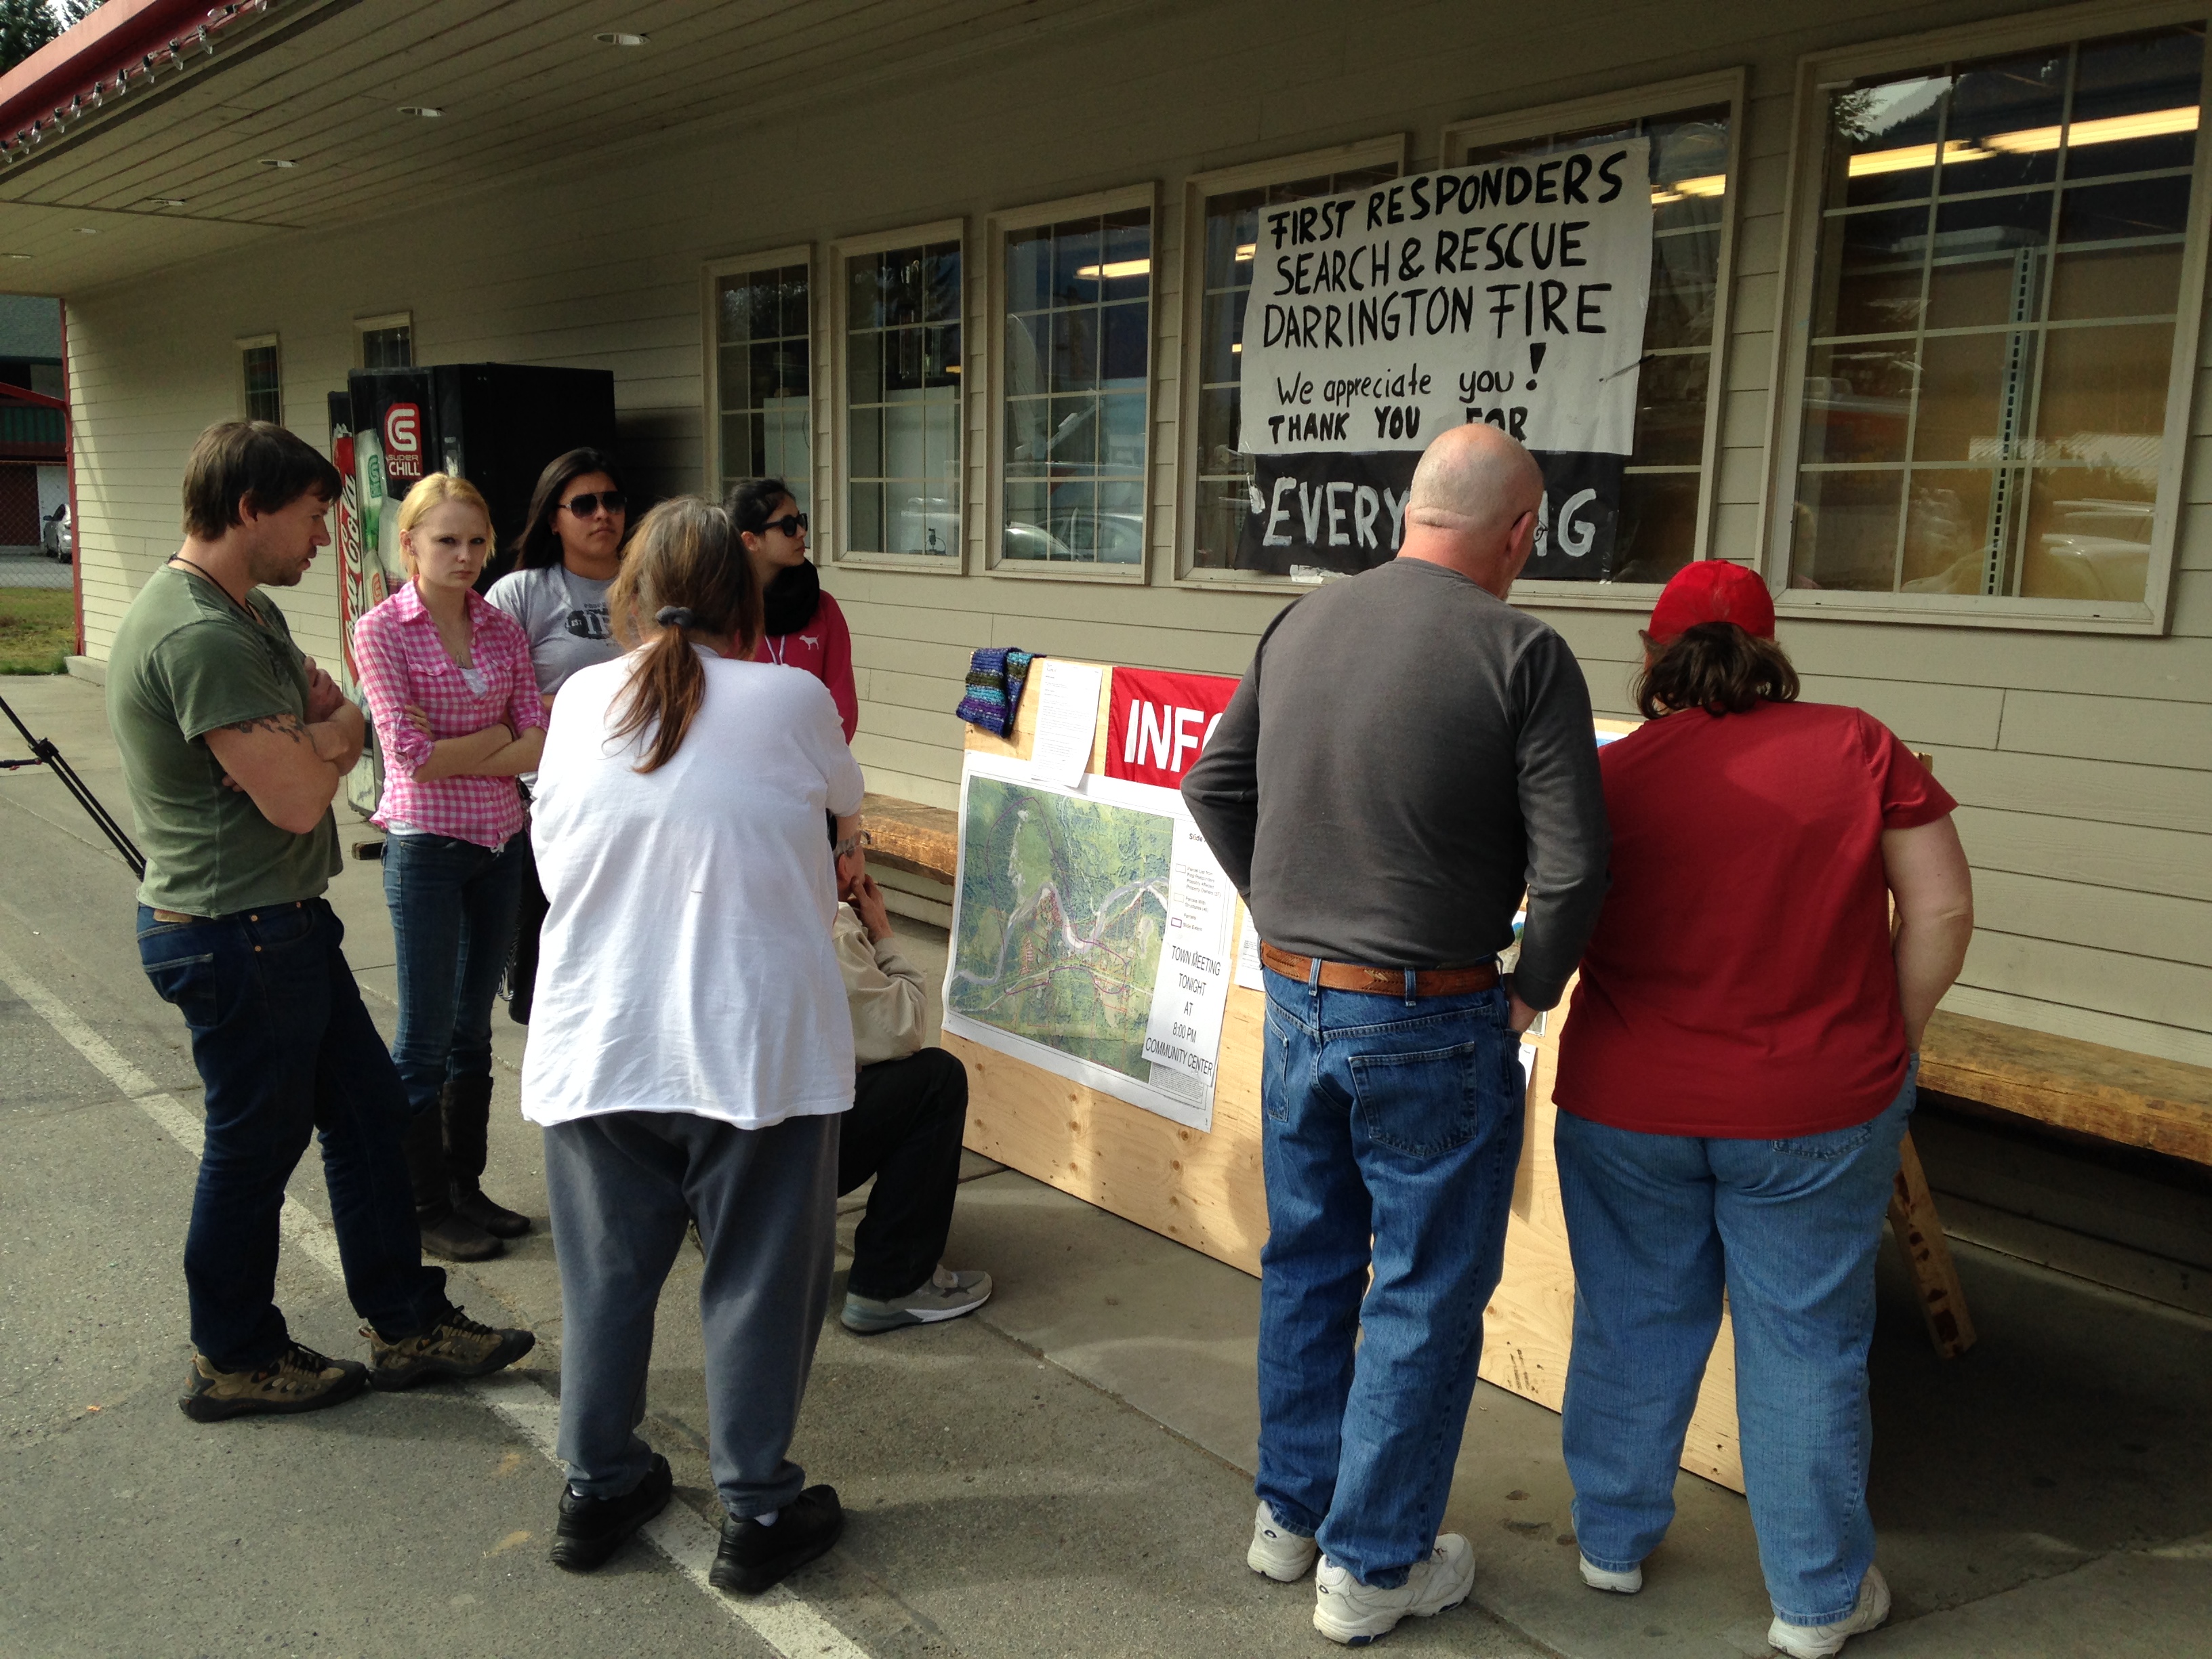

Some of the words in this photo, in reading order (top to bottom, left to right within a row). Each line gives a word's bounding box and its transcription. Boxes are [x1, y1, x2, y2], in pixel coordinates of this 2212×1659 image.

[1268, 200, 1355, 249] FIRST
[1366, 150, 1627, 231] RESPONDERS
[1273, 240, 1390, 296] SEARCH
[1398, 237, 1425, 283] &
[1435, 220, 1591, 274] RESCUE
[1263, 285, 1474, 348] DARRINGTON
[1486, 280, 1612, 338] FIRE
[1277, 371, 1314, 405] We
[1324, 363, 1432, 408] appreciate
[1268, 410, 1351, 445] THANK
[1374, 405, 1421, 440] YOU
[389, 462, 421, 476] CHILL
[1124, 699, 1224, 773] INF
[1172, 945, 1191, 965] TOWN
[1191, 951, 1221, 976] MEETING
[1179, 972, 1207, 996] TONIGHT
[1184, 1001, 1193, 1017] AT
[1172, 1021, 1186, 1039] 8:00
[1186, 1027, 1197, 1043] PM
[1145, 1037, 1188, 1065] COMMUNITY
[1187, 1053, 1213, 1077] CENTER
